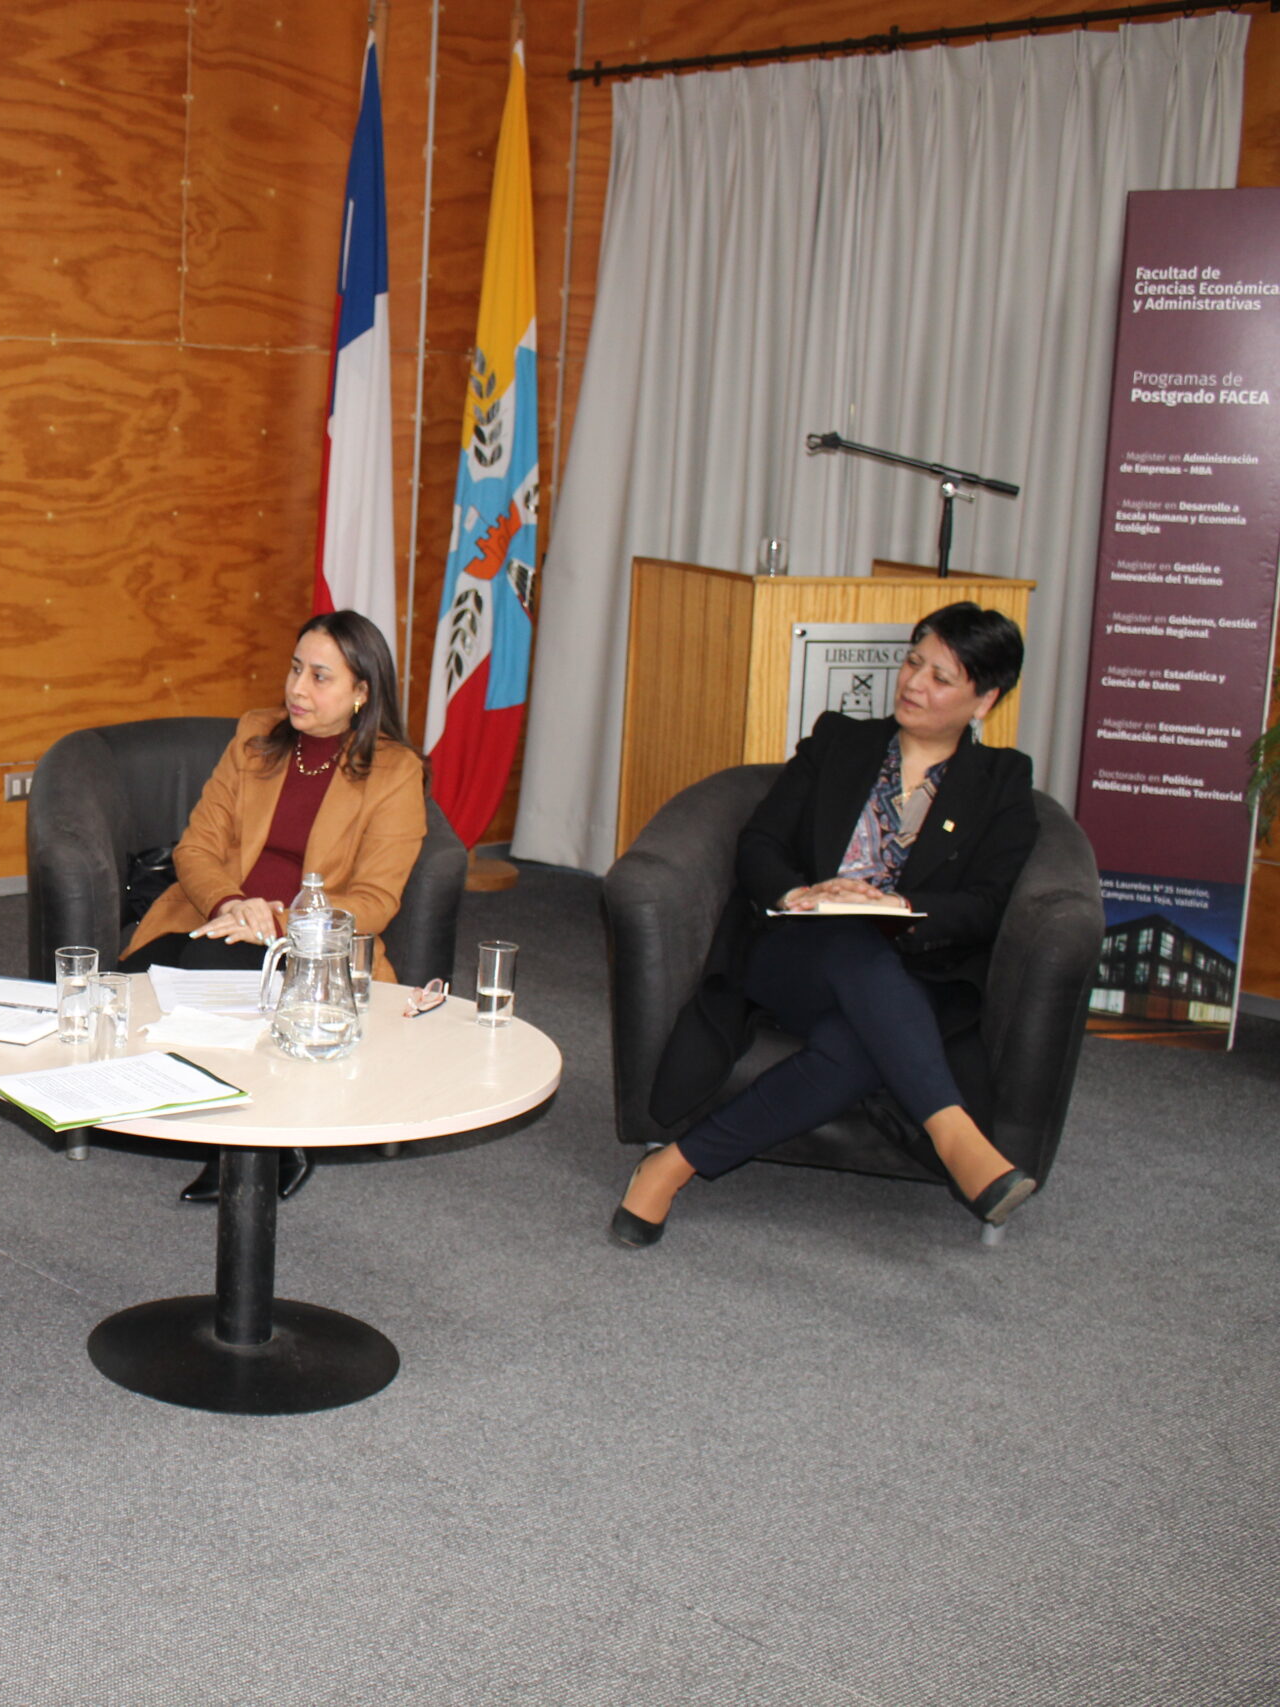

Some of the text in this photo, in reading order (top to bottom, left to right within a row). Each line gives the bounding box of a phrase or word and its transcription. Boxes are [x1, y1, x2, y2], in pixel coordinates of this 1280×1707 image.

[1135, 266, 1221, 280] Facultad de
[1134, 281, 1280, 296] Ciencias Económica
[1132, 297, 1262, 313] y Administrativas
[1132, 371, 1243, 389] Programas de
[1131, 388, 1270, 406] Postgrado FACEA
[1182, 453, 1259, 465] Administración
[1120, 463, 1133, 473] de
[1134, 463, 1182, 475] Empresas
[1189, 465, 1213, 475] MBA
[1179, 501, 1230, 512] Desarrollo
[1116, 510, 1146, 521] Escala
[1148, 512, 1188, 523] Humana
[1173, 562, 1212, 574] Gestión
[1165, 573, 1181, 584] del
[1183, 575, 1223, 586] Turismo
[1218, 618, 1257, 629] Gestión
[1114, 623, 1164, 636] Desarrollo
[1166, 627, 1209, 639] Regional
[825, 648, 890, 663] LIBERTAS
[1101, 676, 1181, 692] Ciencia de Datos
[1207, 727, 1229, 738] para
[1231, 727, 1241, 737] la
[1159, 733, 1175, 745] del
[1177, 735, 1228, 749] Desarrollo
[1098, 768, 1146, 782] Doctorado
[1141, 784, 1191, 798] Desarrollo
[1193, 788, 1243, 802] Territorial
